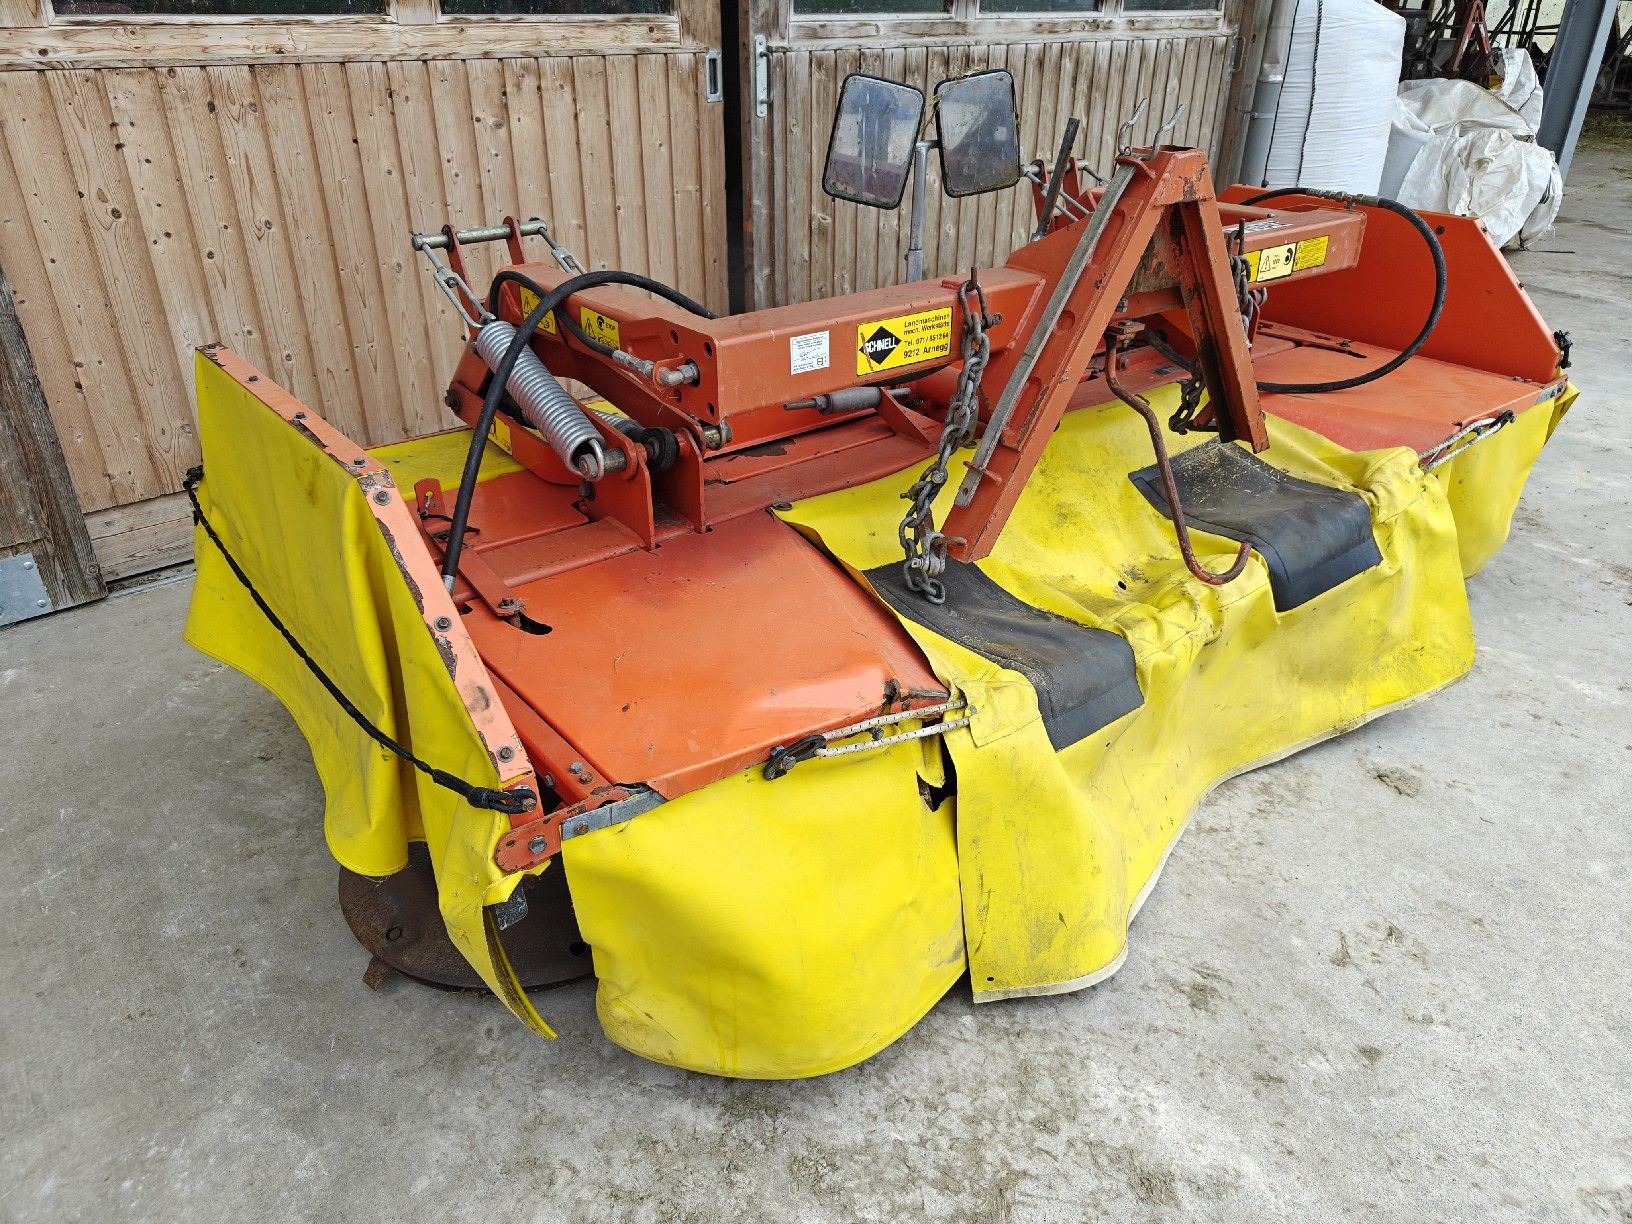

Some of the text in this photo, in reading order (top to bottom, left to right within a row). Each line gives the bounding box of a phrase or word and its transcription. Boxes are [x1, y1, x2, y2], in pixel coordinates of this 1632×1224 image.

[904, 314, 950, 328] Landmaschinen
[864, 337, 896, 352] SCHNELL
[904, 339, 915, 347] Tel.
[904, 343, 948, 359] 9212 Arnegg
